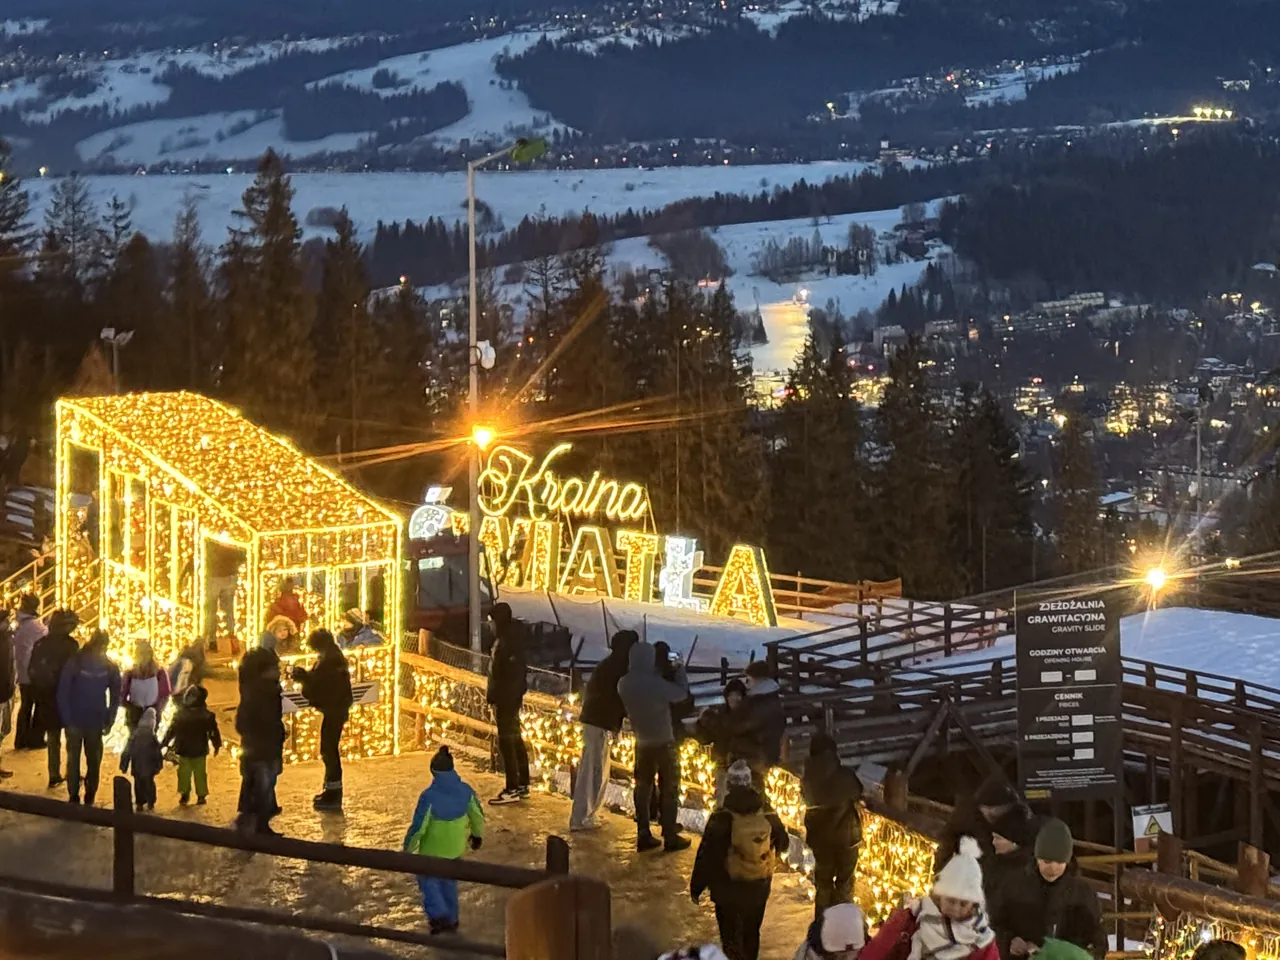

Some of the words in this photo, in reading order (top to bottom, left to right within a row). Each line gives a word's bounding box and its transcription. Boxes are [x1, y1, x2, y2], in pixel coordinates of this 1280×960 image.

[478, 443, 647, 520] Kraina
[1039, 600, 1106, 611] ZJEŻDŻALNIA
[1028, 613, 1106, 624] GRAWITACYJNA
[1052, 625, 1083, 633] GRAVITY
[1084, 624, 1106, 632] SLIDE
[1029, 648, 1064, 657] GODZINY
[1065, 646, 1107, 655] OTWARCIA
[1054, 692, 1083, 700] CENNIK
